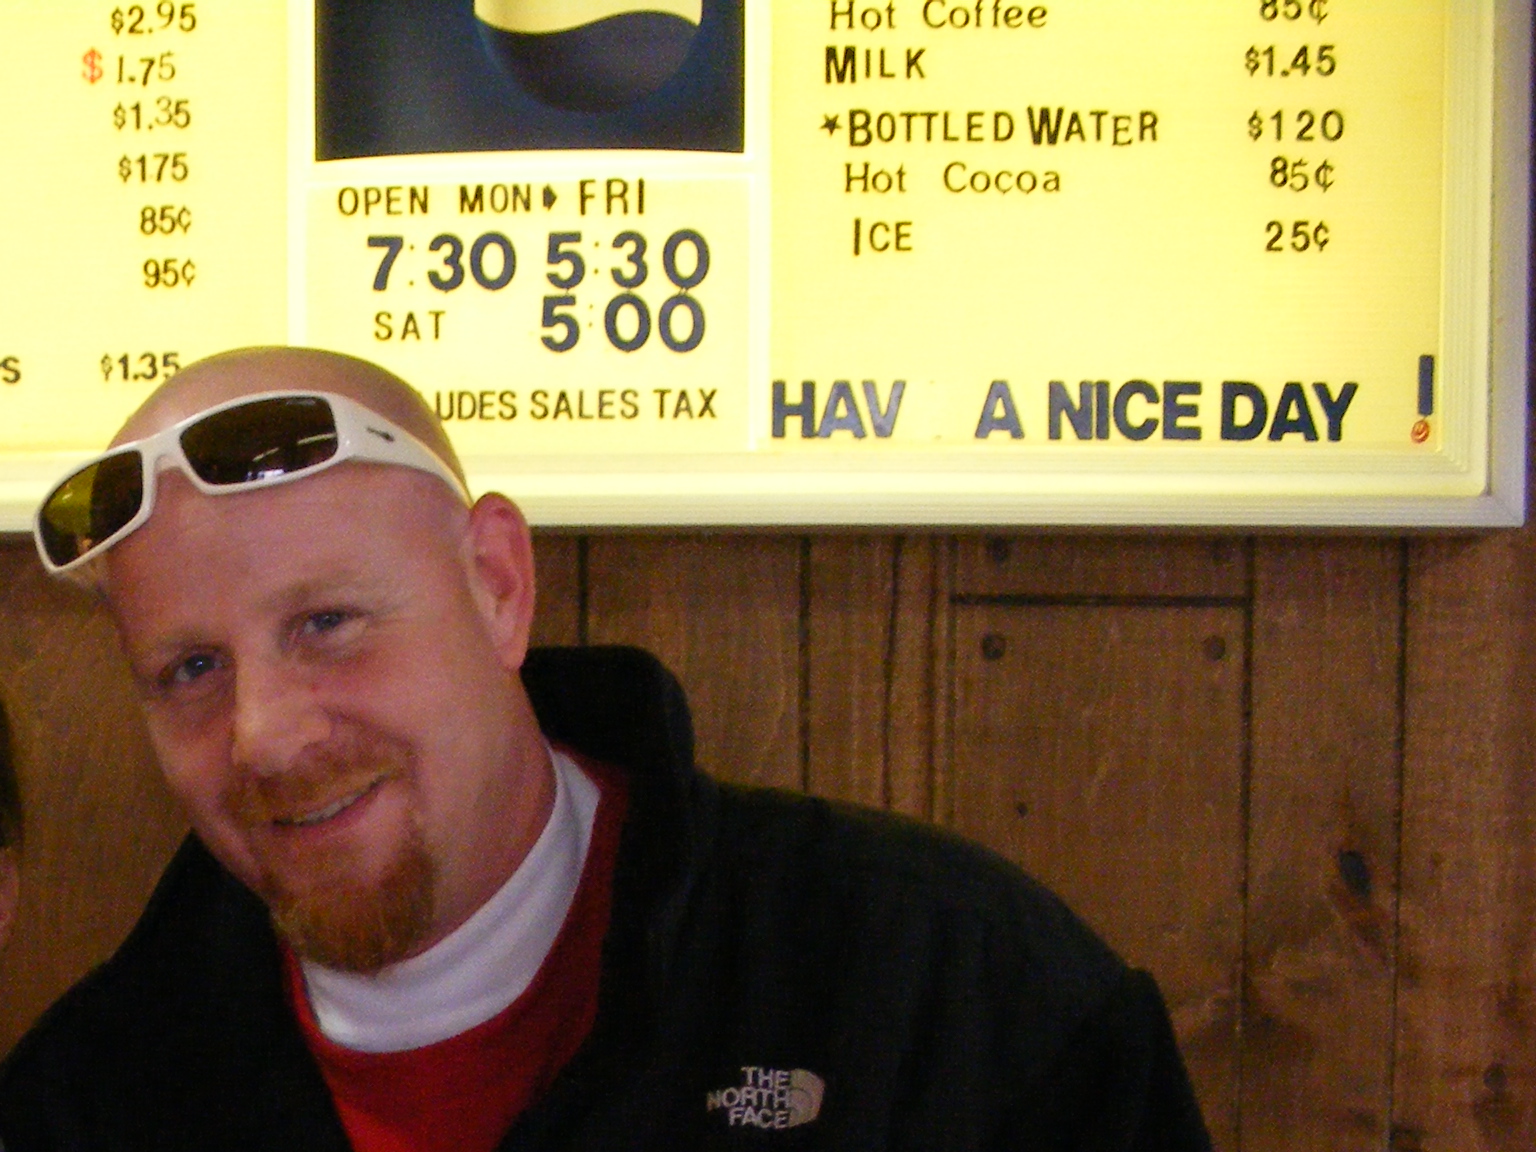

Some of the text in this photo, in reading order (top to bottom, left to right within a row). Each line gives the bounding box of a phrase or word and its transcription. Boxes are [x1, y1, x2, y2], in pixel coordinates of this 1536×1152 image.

[110, 0, 198, 36] $2.95
[830, 0, 1048, 32] Hot Coffee
[825, 45, 926, 84] MILK
[1245, 44, 1338, 79] $1.45
[113, 97, 192, 131] $1.35
[848, 105, 1159, 148] BOTTLED WATER
[844, 161, 1062, 195] Hot Cocoa
[1269, 155, 1335, 193] 85¢
[337, 178, 646, 216] OPEN MON FRI
[139, 205, 192, 236] 85¢
[853, 217, 913, 257] ICE
[1265, 221, 1330, 254] 25¢
[142, 258, 196, 289] 95¢
[366, 228, 711, 292] 7:30 5:30
[374, 293, 706, 354] SAT 5:00
[100, 352, 180, 382] $1.35
[529, 389, 640, 421] SALES
[653, 388, 718, 420] TAX
[973, 379, 1026, 441] A
[1046, 379, 1204, 442] NICE
[1219, 380, 1359, 443] DAY
[741, 1065, 791, 1088] THE
[706, 1086, 790, 1110] NORTH
[728, 1106, 791, 1130] FACE
